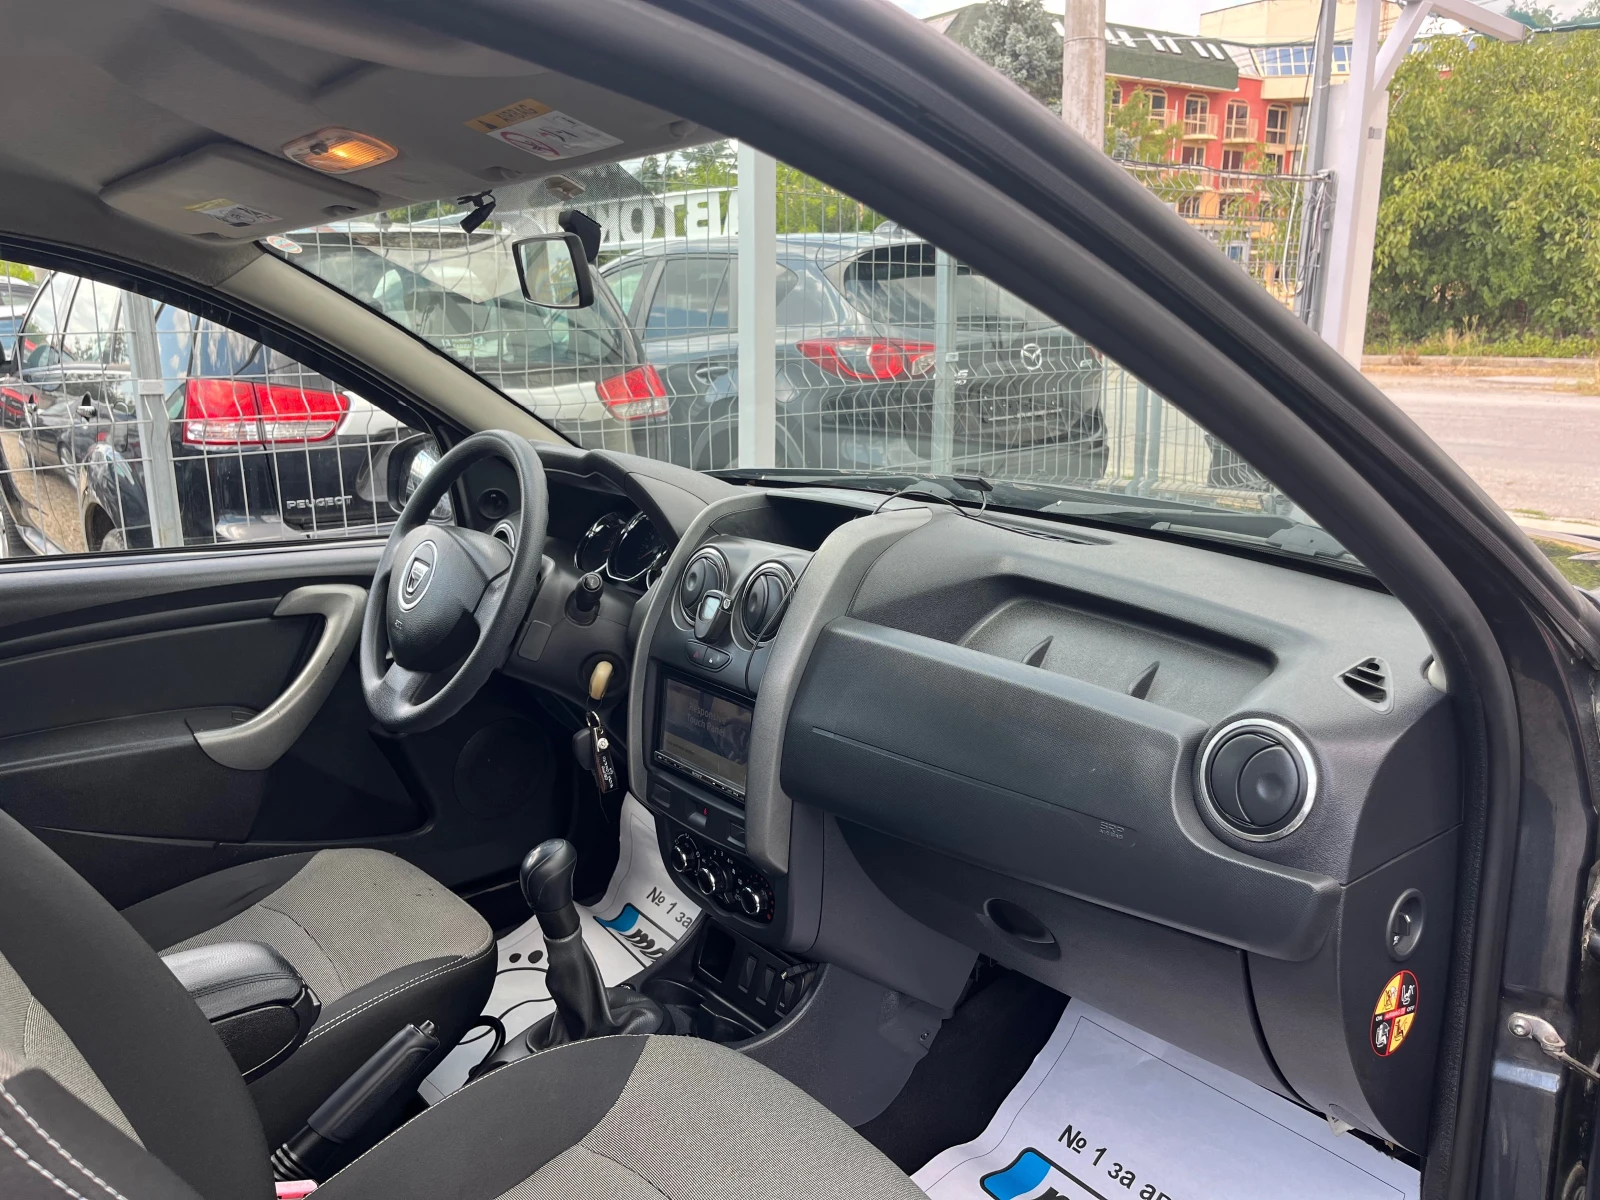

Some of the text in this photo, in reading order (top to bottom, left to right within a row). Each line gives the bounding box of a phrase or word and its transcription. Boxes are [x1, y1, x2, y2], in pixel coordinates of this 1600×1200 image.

[286, 495, 352, 509] PEUGEOT
[687, 713, 725, 737] Touch Panel
[689, 702, 727, 725] Responsive
[646, 887, 693, 928] № 1 за
[1057, 1124, 1088, 1154] №
[1092, 1147, 1108, 1167] 1
[1107, 1162, 1136, 1189] за
